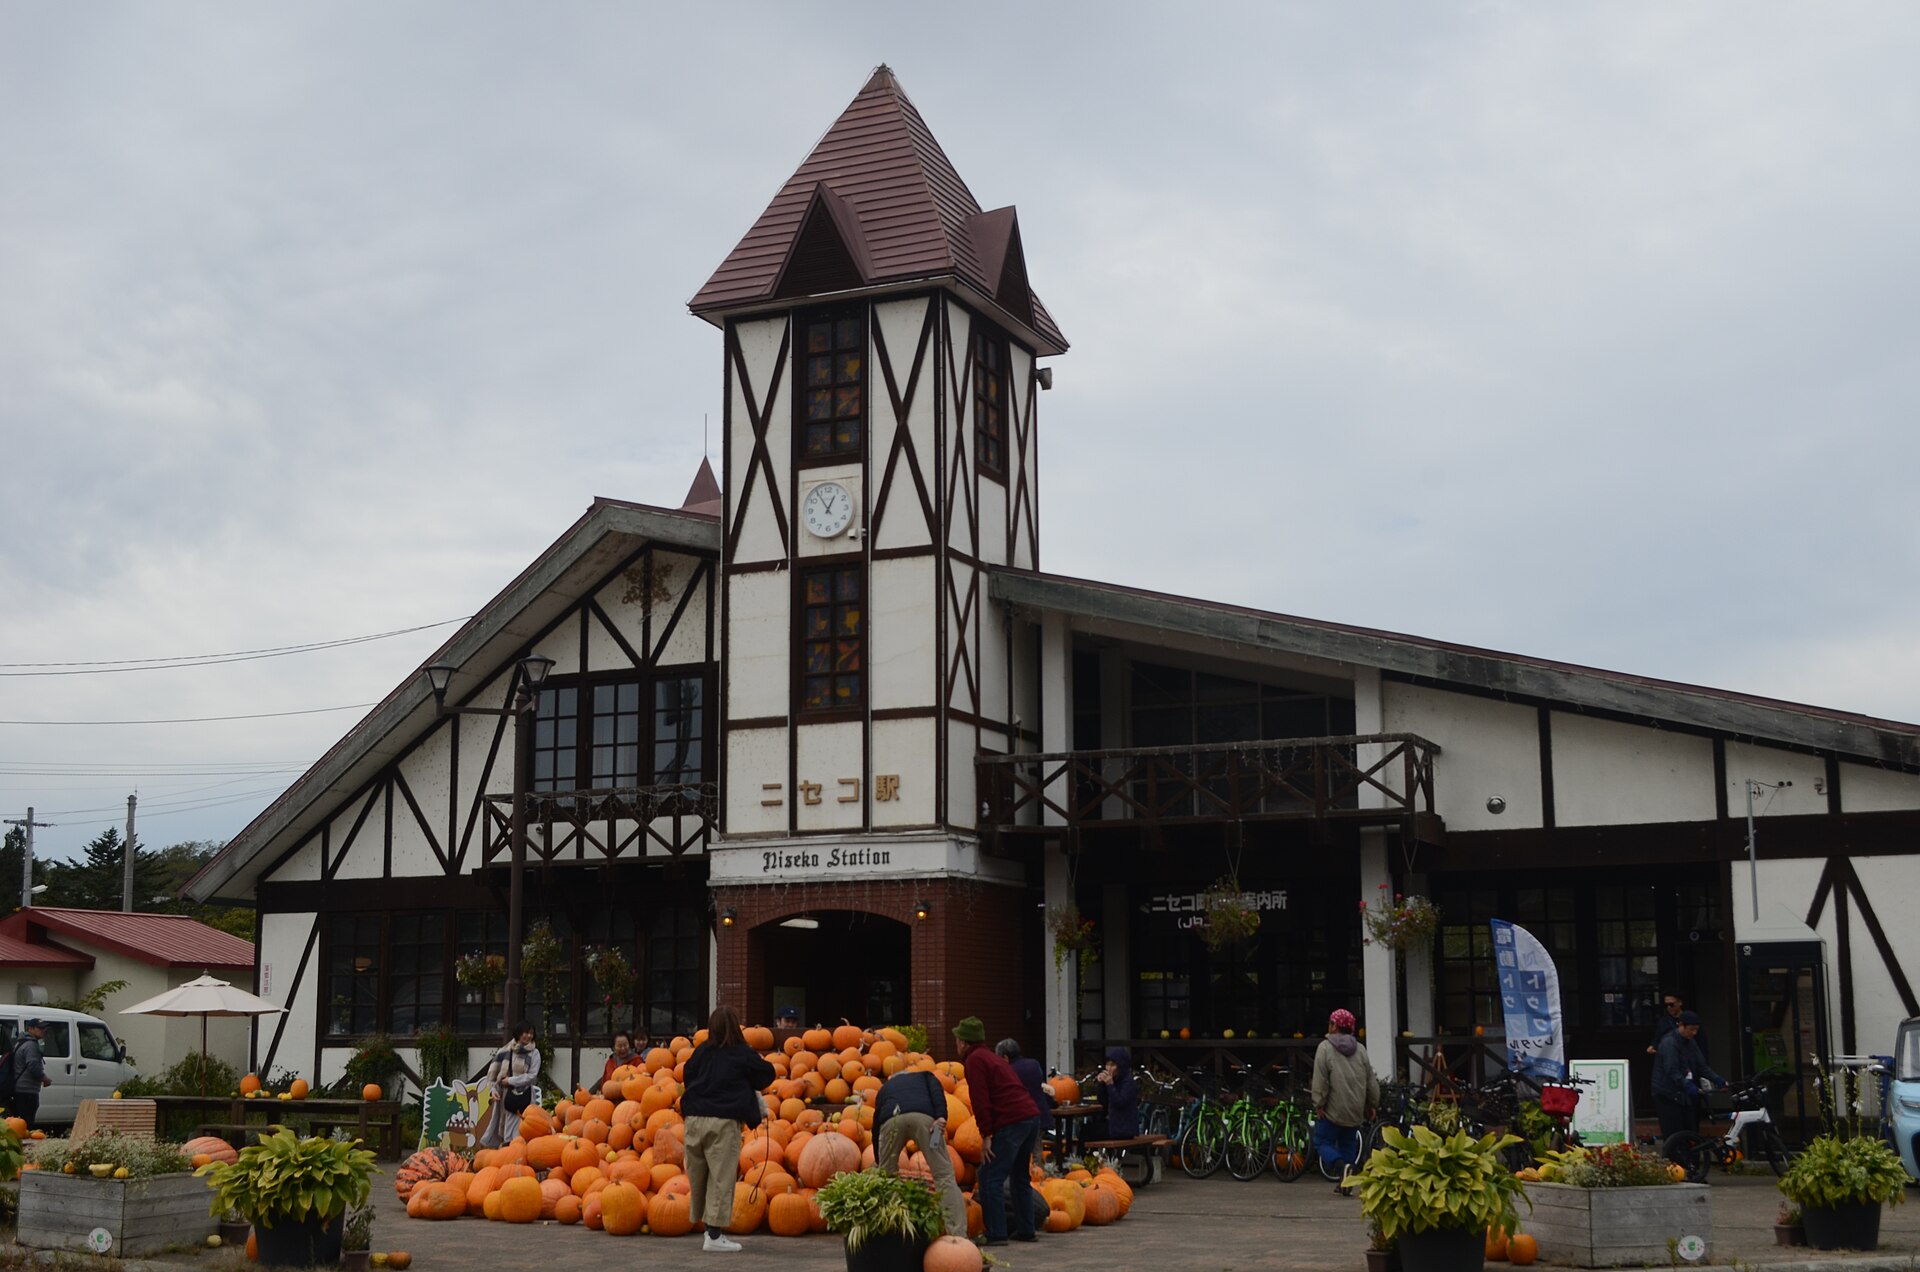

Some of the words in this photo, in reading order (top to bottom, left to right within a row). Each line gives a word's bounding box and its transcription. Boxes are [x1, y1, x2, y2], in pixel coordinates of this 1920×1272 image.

[761, 774, 900, 807] ニセコ駅
[763, 850, 819, 873] Niseko
[826, 848, 891, 868] Station
